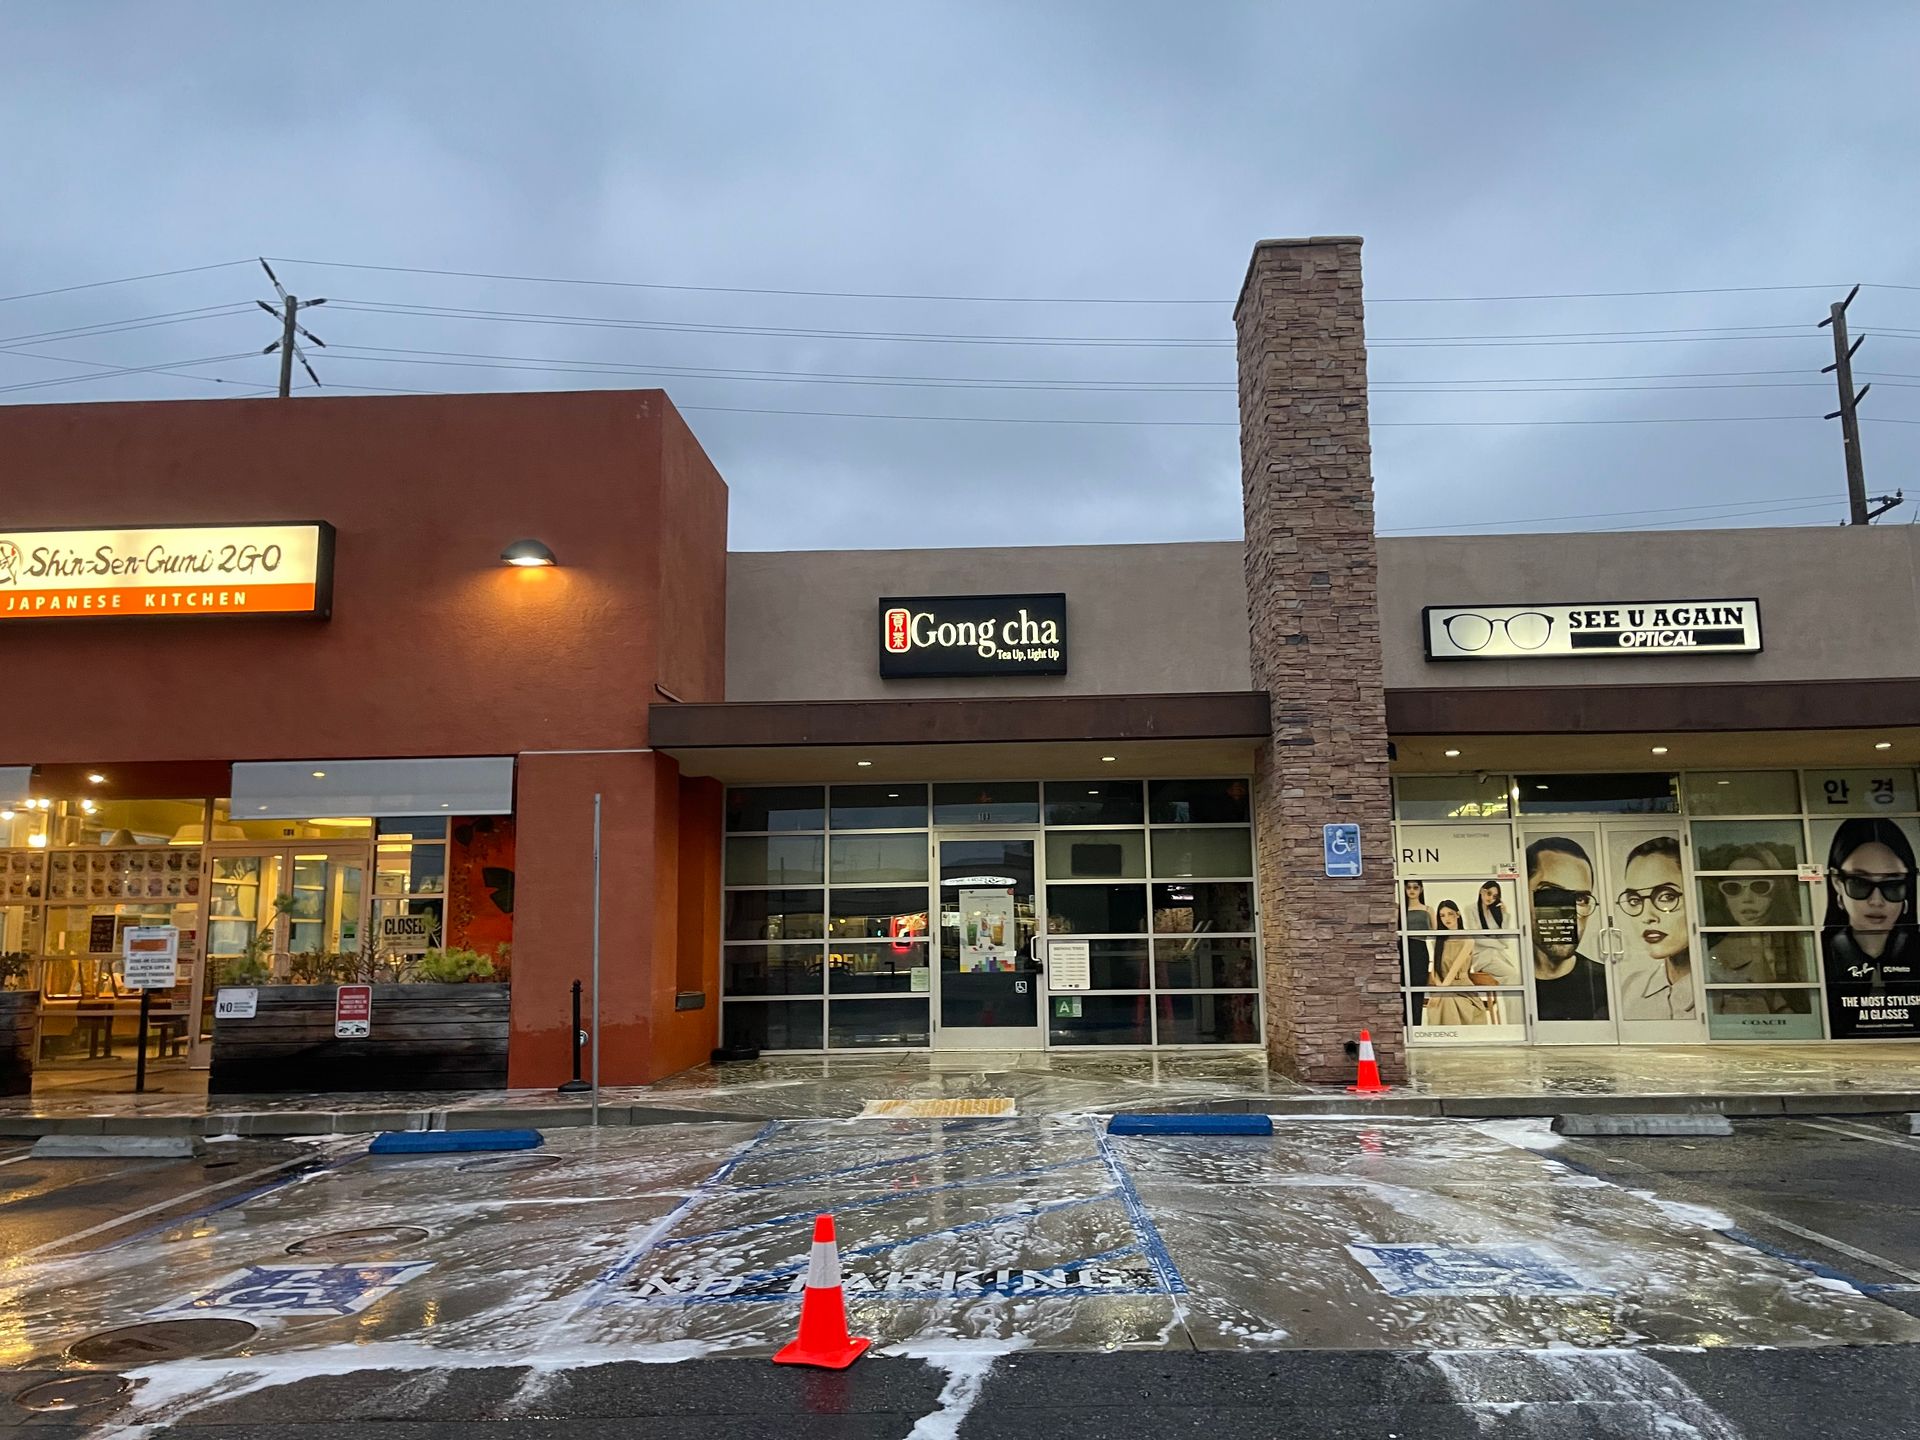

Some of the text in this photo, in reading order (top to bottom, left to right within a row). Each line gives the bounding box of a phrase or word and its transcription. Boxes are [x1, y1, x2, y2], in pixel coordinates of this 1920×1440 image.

[217, 544, 282, 571] 2GO
[6, 591, 247, 610] JAPANESE KITCHEN
[1568, 606, 1745, 629] SEE U AGAIN
[911, 608, 1060, 658] Gong cha
[1618, 630, 1698, 648] OPTICAL
[997, 648, 1060, 662] Tea Up, Light Up
[219, 1002, 232, 1013] NO
[1059, 1001, 1070, 1013] A
[1841, 996, 1859, 1007] THE
[1860, 996, 1885, 1007] MOST
[1859, 1008, 1909, 1020] AI GLASSES
